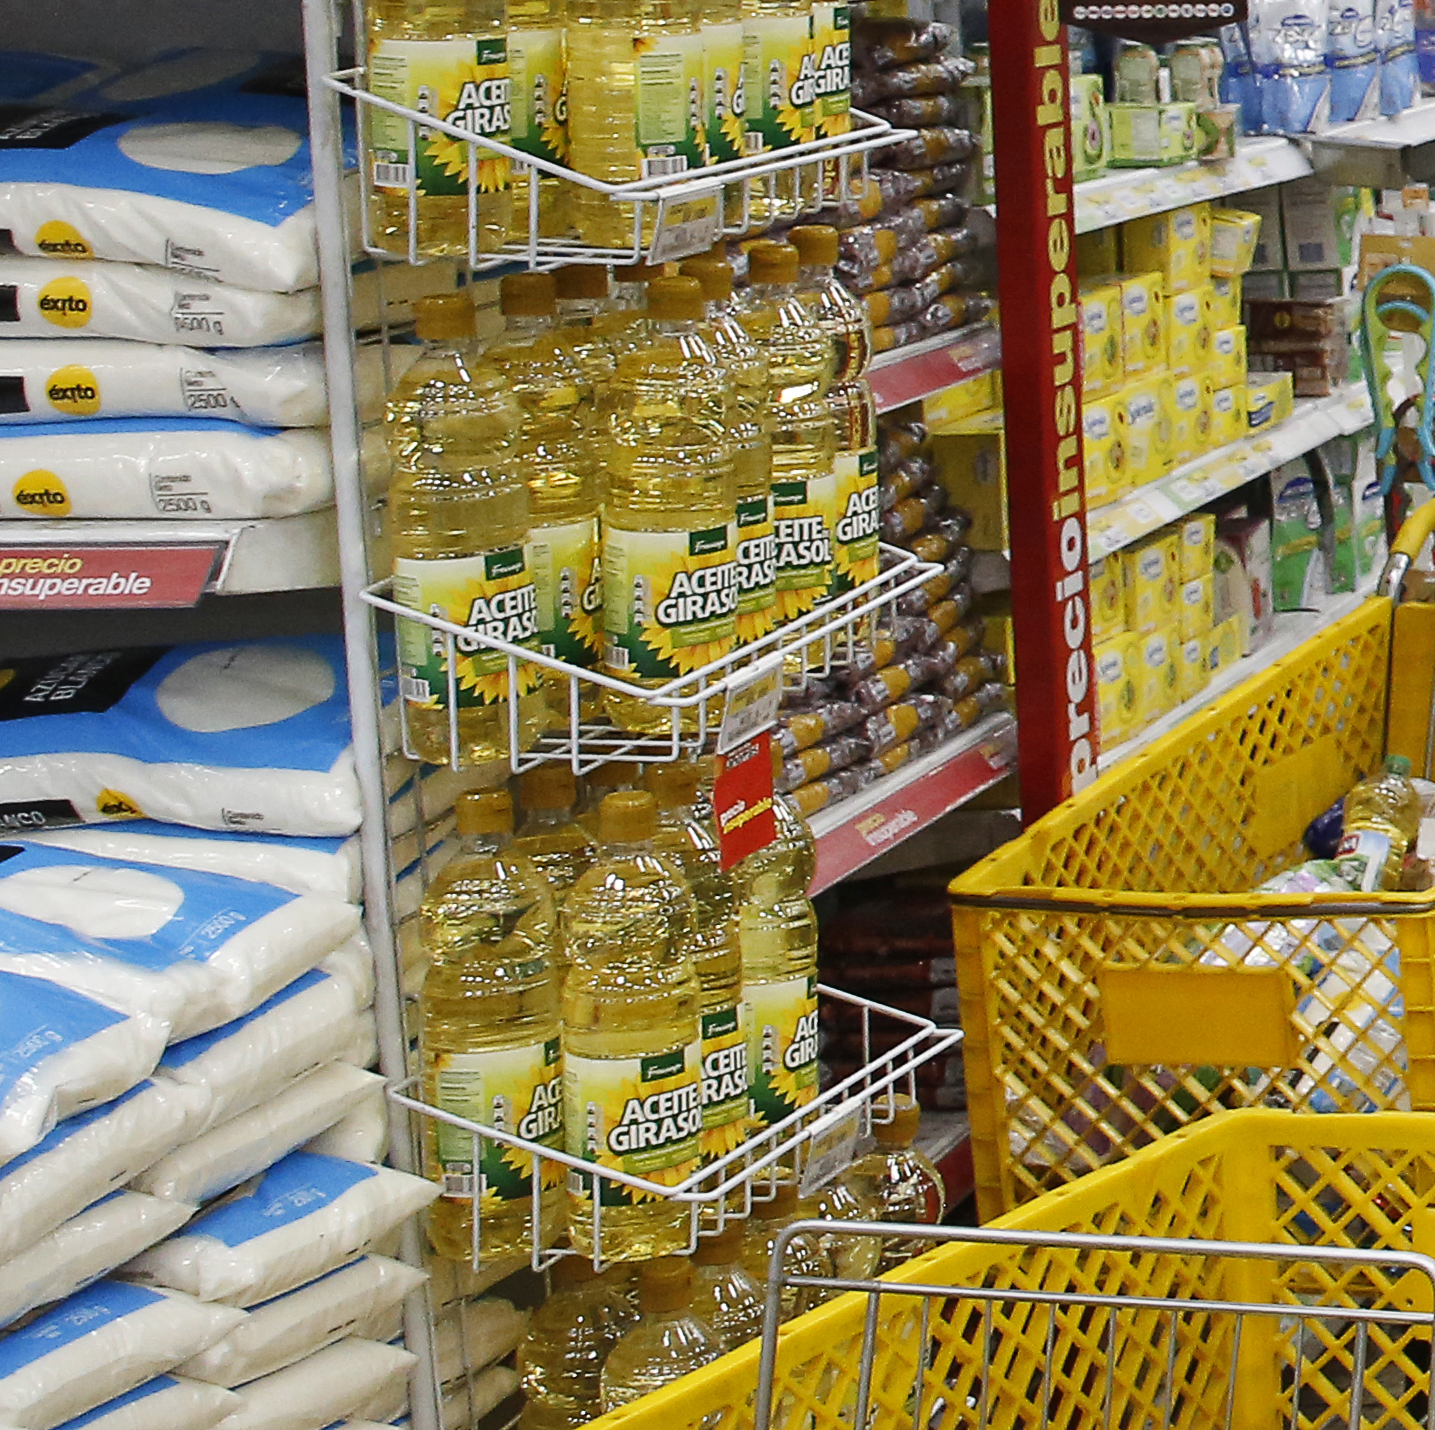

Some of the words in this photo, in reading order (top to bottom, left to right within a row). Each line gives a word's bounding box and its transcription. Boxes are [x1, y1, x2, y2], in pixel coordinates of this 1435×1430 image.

[40, 293, 88, 316] éxito
[48, 383, 96, 403] éxito
[16, 489, 65, 508] éxito
[1056, 516, 1098, 798] precio
